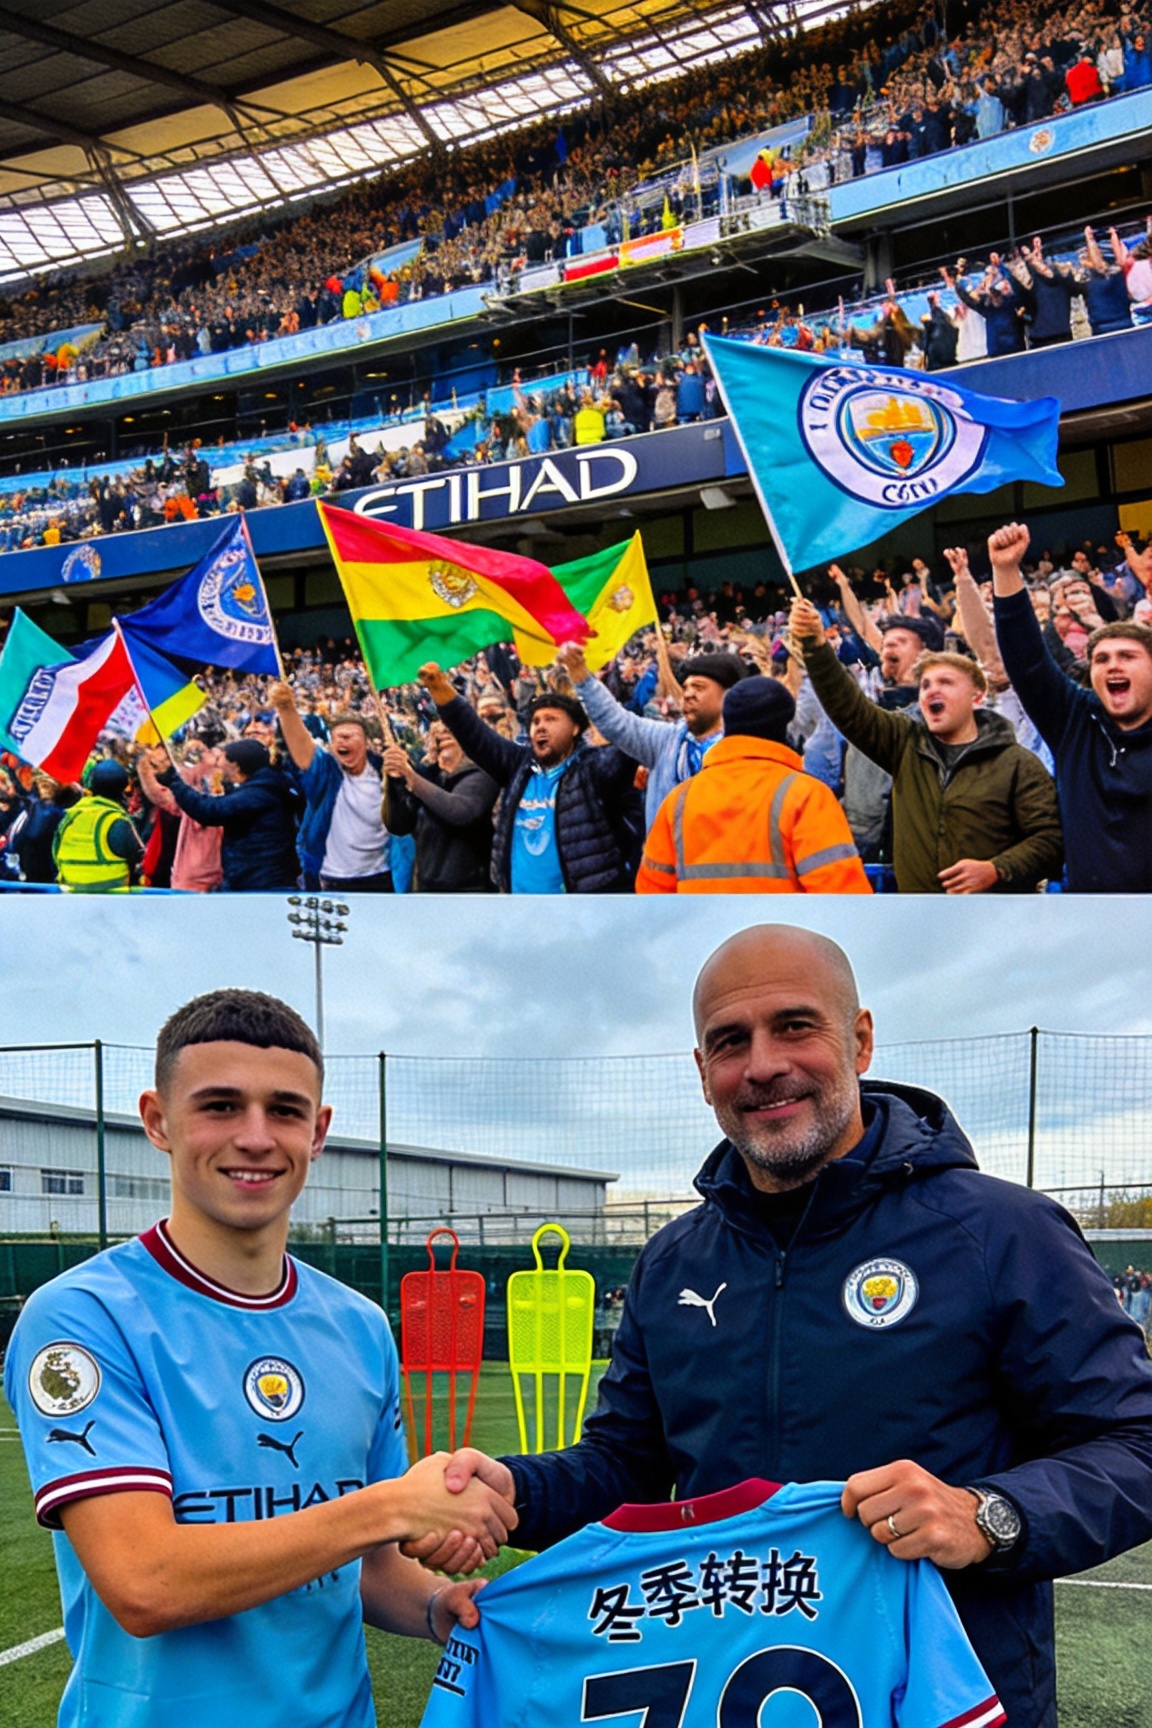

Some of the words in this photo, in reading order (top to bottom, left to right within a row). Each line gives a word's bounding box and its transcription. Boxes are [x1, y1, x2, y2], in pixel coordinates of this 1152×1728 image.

[353, 448, 638, 531] ETIHAD
[588, 1548, 822, 1642] 冬季转换
